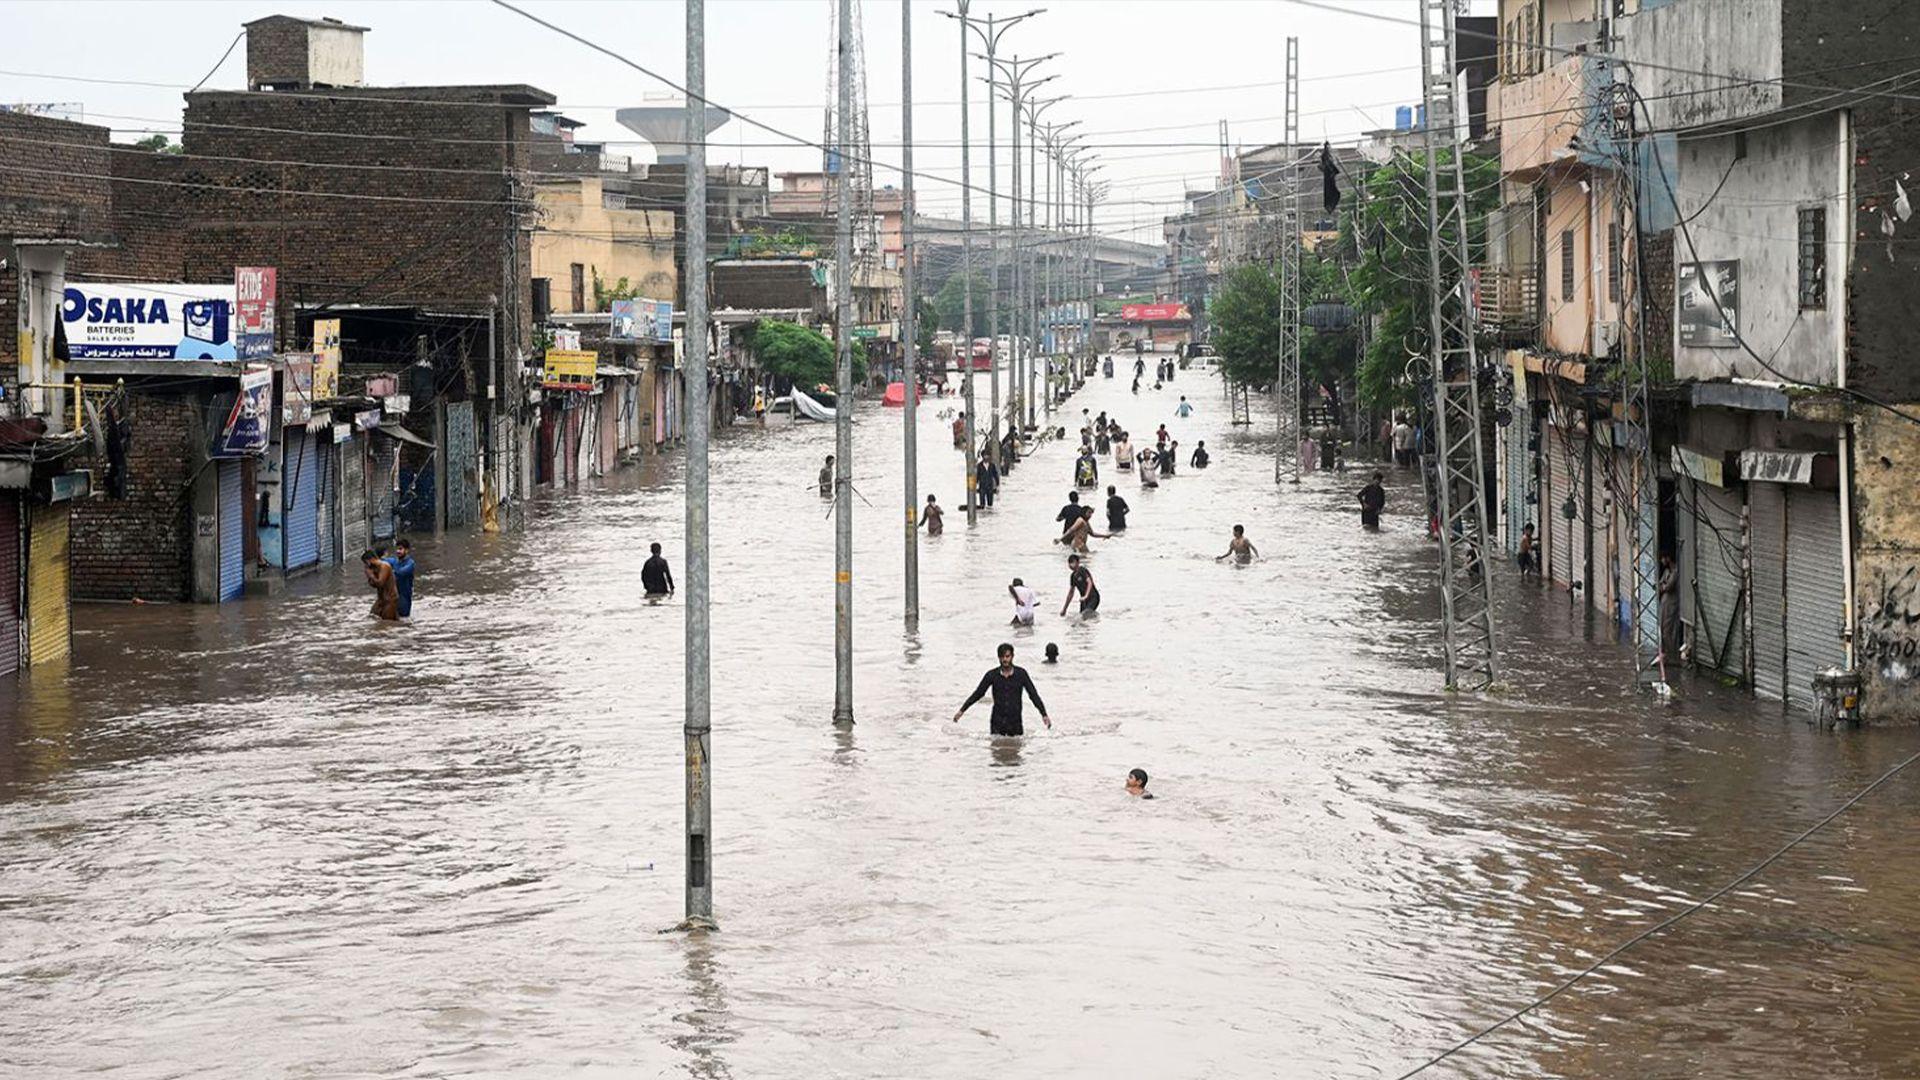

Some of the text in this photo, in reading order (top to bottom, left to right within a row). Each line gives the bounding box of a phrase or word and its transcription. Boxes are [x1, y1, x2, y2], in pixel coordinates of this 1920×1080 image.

[239, 271, 262, 300] EXIDE
[63, 288, 169, 324] OSAKA
[87, 326, 135, 334] BATTERIES
